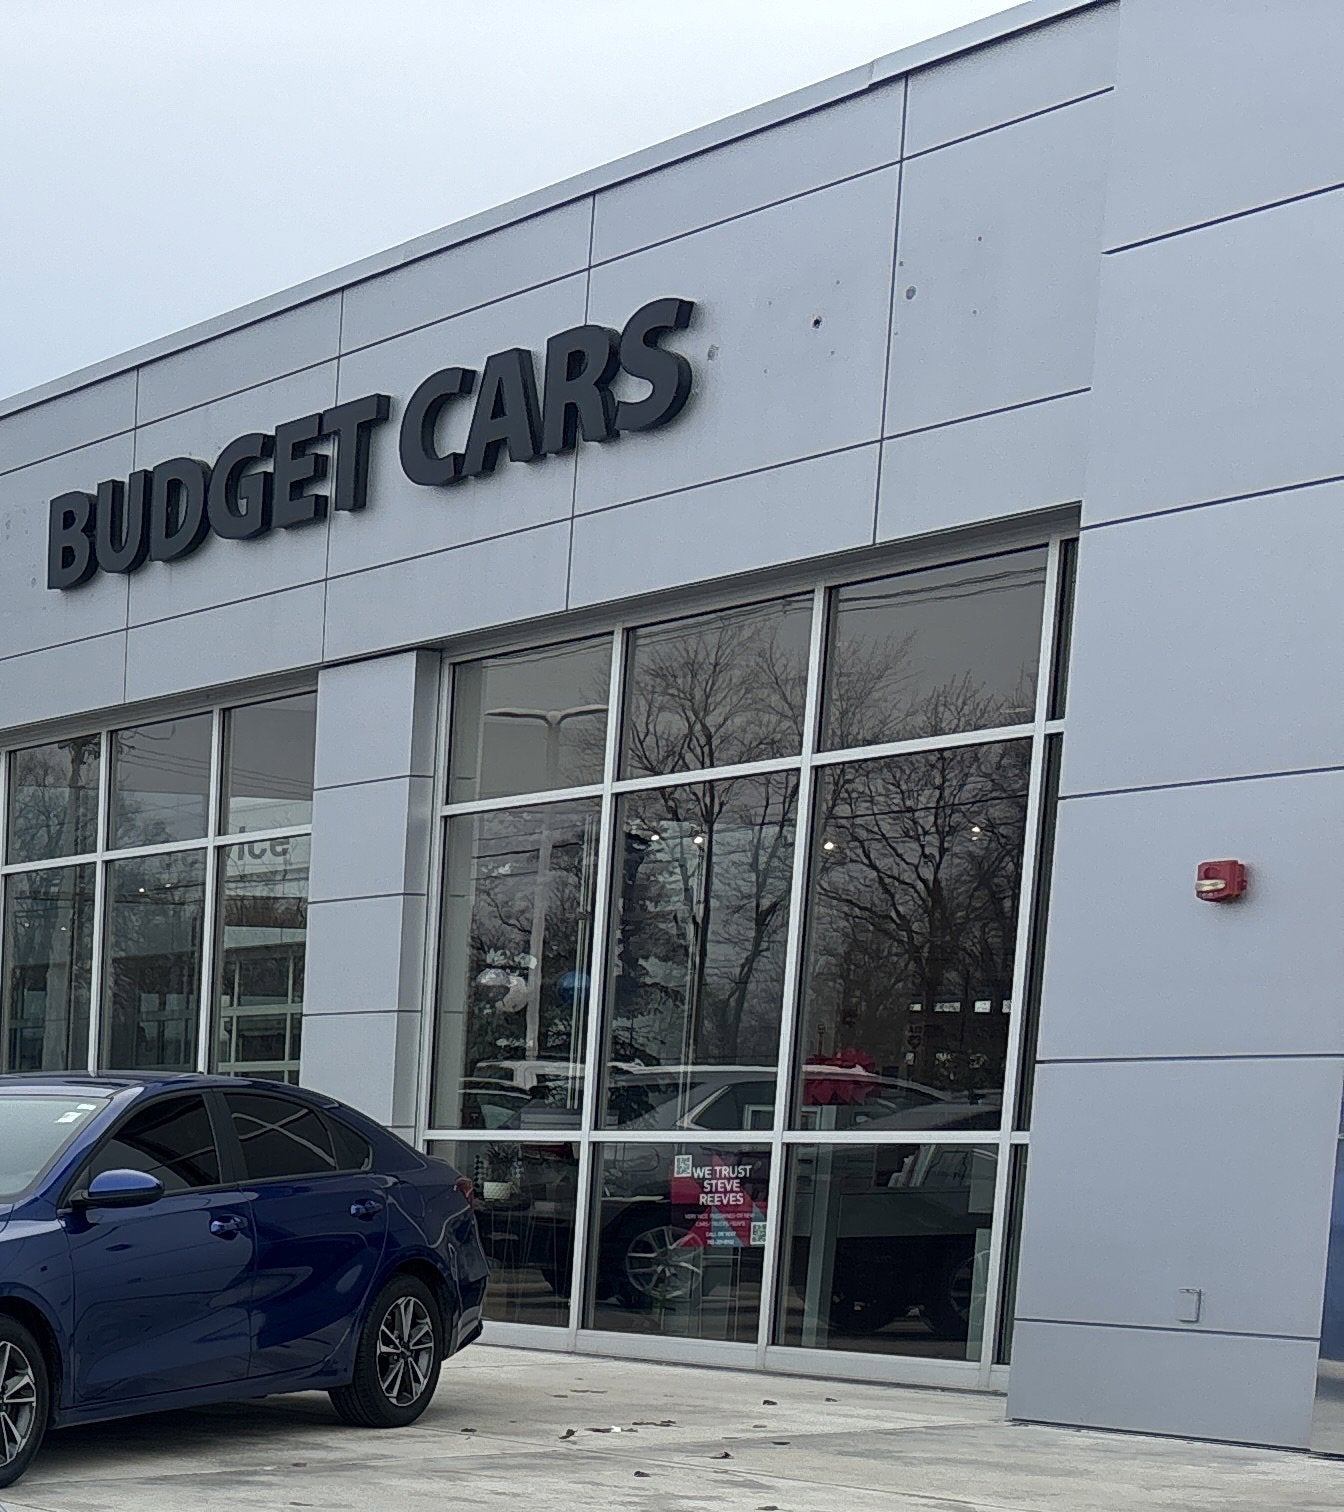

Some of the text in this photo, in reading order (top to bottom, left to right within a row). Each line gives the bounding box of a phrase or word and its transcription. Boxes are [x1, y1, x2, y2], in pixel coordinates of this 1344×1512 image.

[48, 298, 695, 590] BUDGET CARS
[693, 1165, 752, 1178] WE TRUST
[703, 1179, 740, 1192] STEVE
[699, 1193, 744, 1205] REEVES
